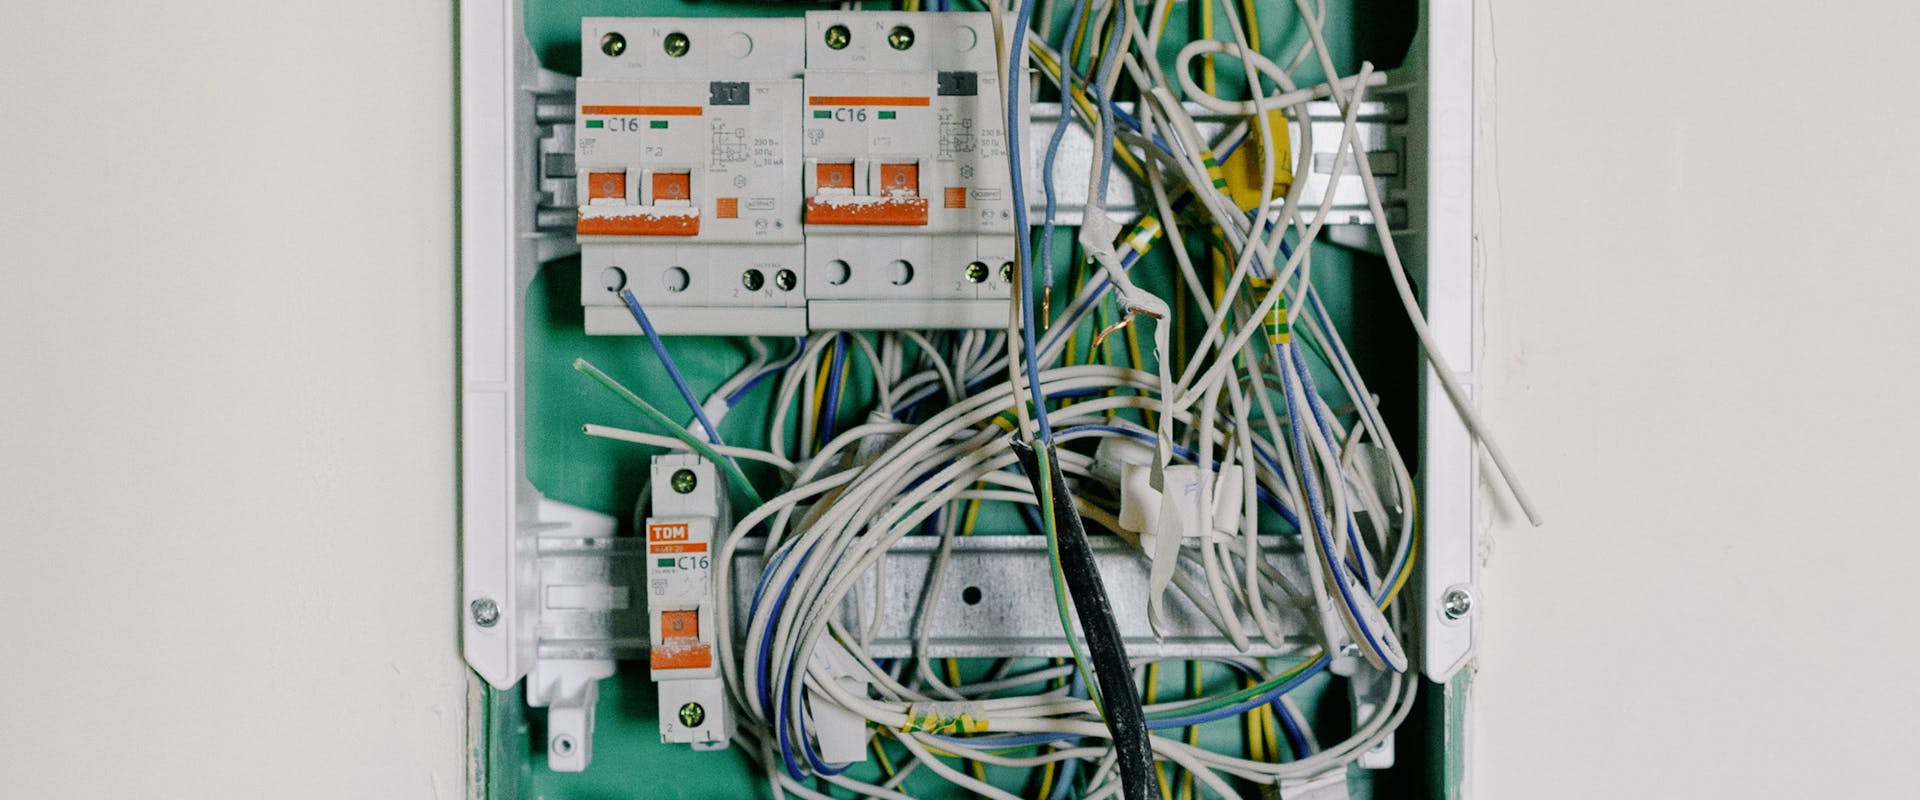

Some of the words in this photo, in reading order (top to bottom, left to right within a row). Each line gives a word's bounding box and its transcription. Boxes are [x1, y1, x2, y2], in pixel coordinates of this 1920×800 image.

[876, 22, 884, 30] N
[652, 28, 660, 37] N
[834, 107, 867, 122] C16
[608, 117, 639, 132] C16
[955, 281, 963, 292] 2
[988, 281, 997, 291] N
[733, 288, 740, 298] 2
[765, 288, 774, 298] N
[653, 526, 685, 539] TDM
[678, 555, 709, 570] C16
[667, 723, 673, 733] 2
